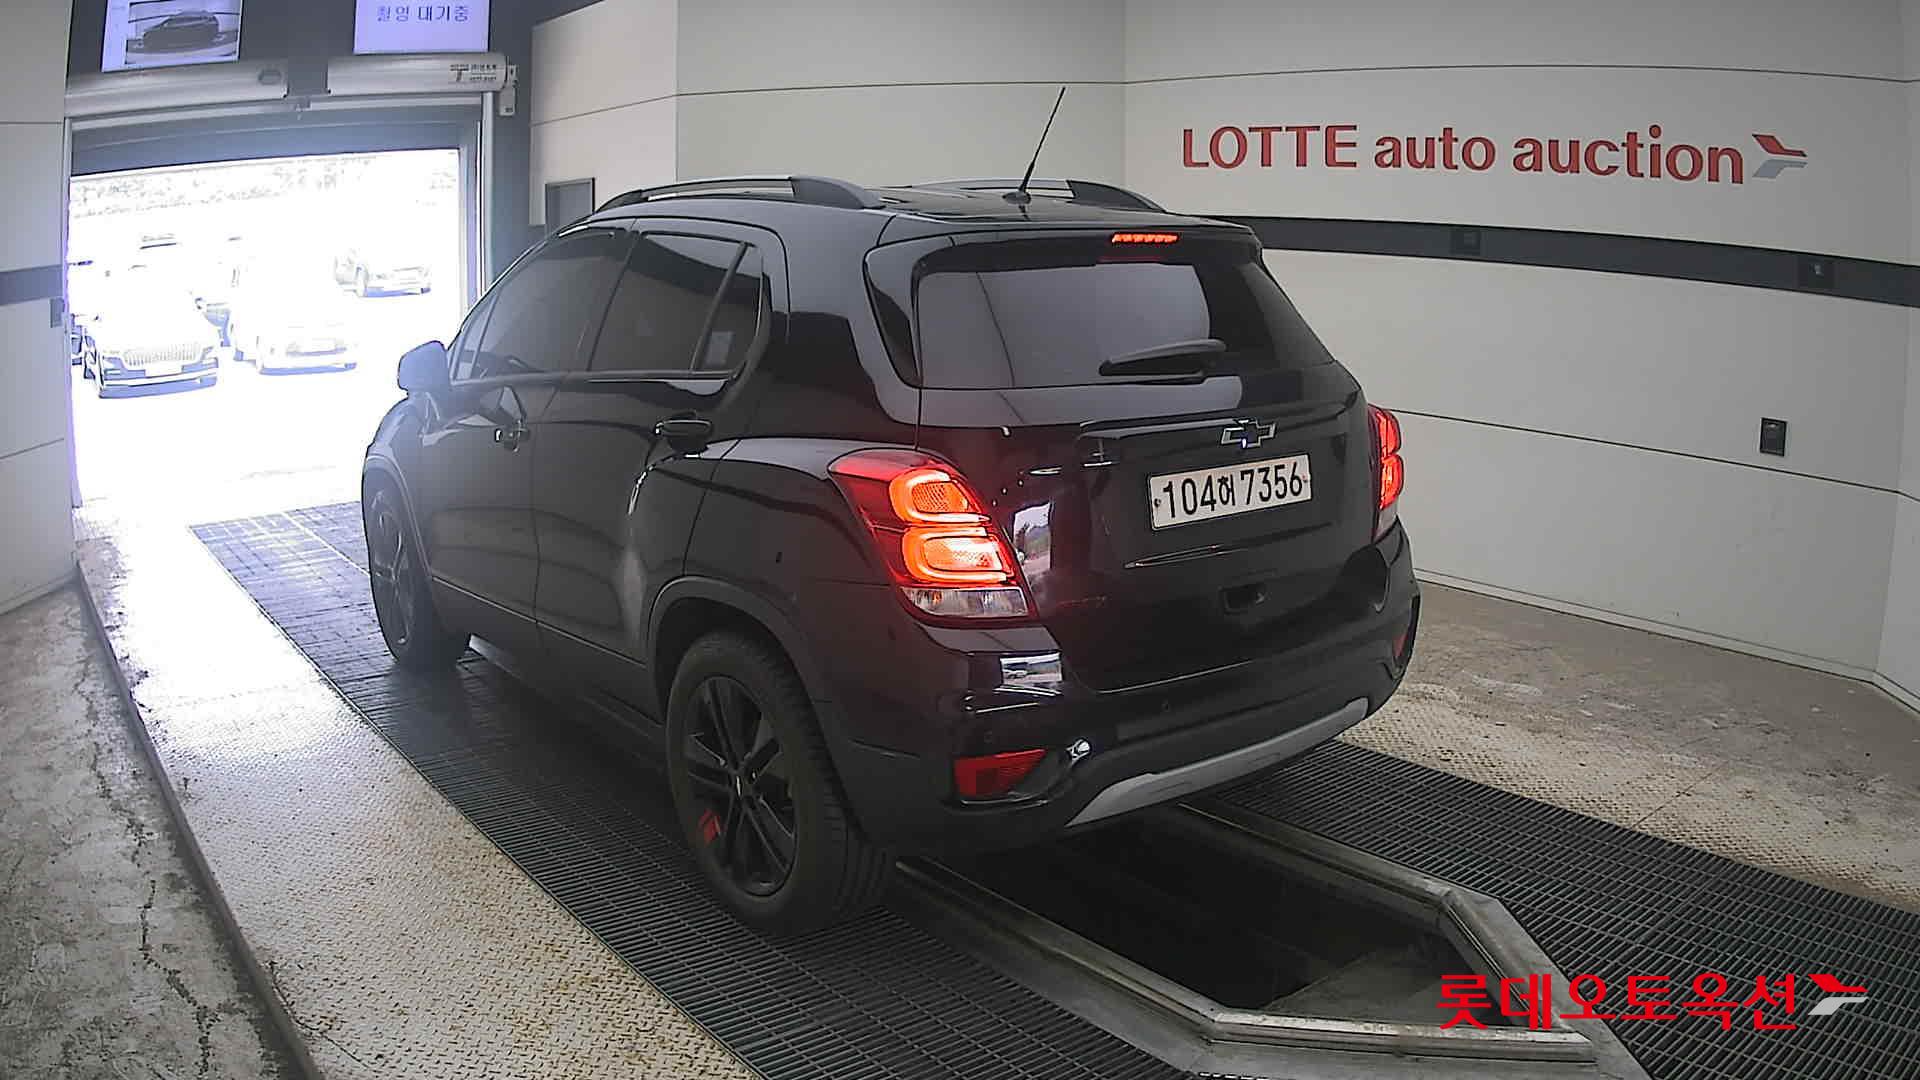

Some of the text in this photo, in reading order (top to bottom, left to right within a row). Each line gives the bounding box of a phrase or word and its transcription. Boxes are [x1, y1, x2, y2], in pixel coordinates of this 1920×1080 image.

[1183, 124, 1744, 184] LOTTE auto auction
